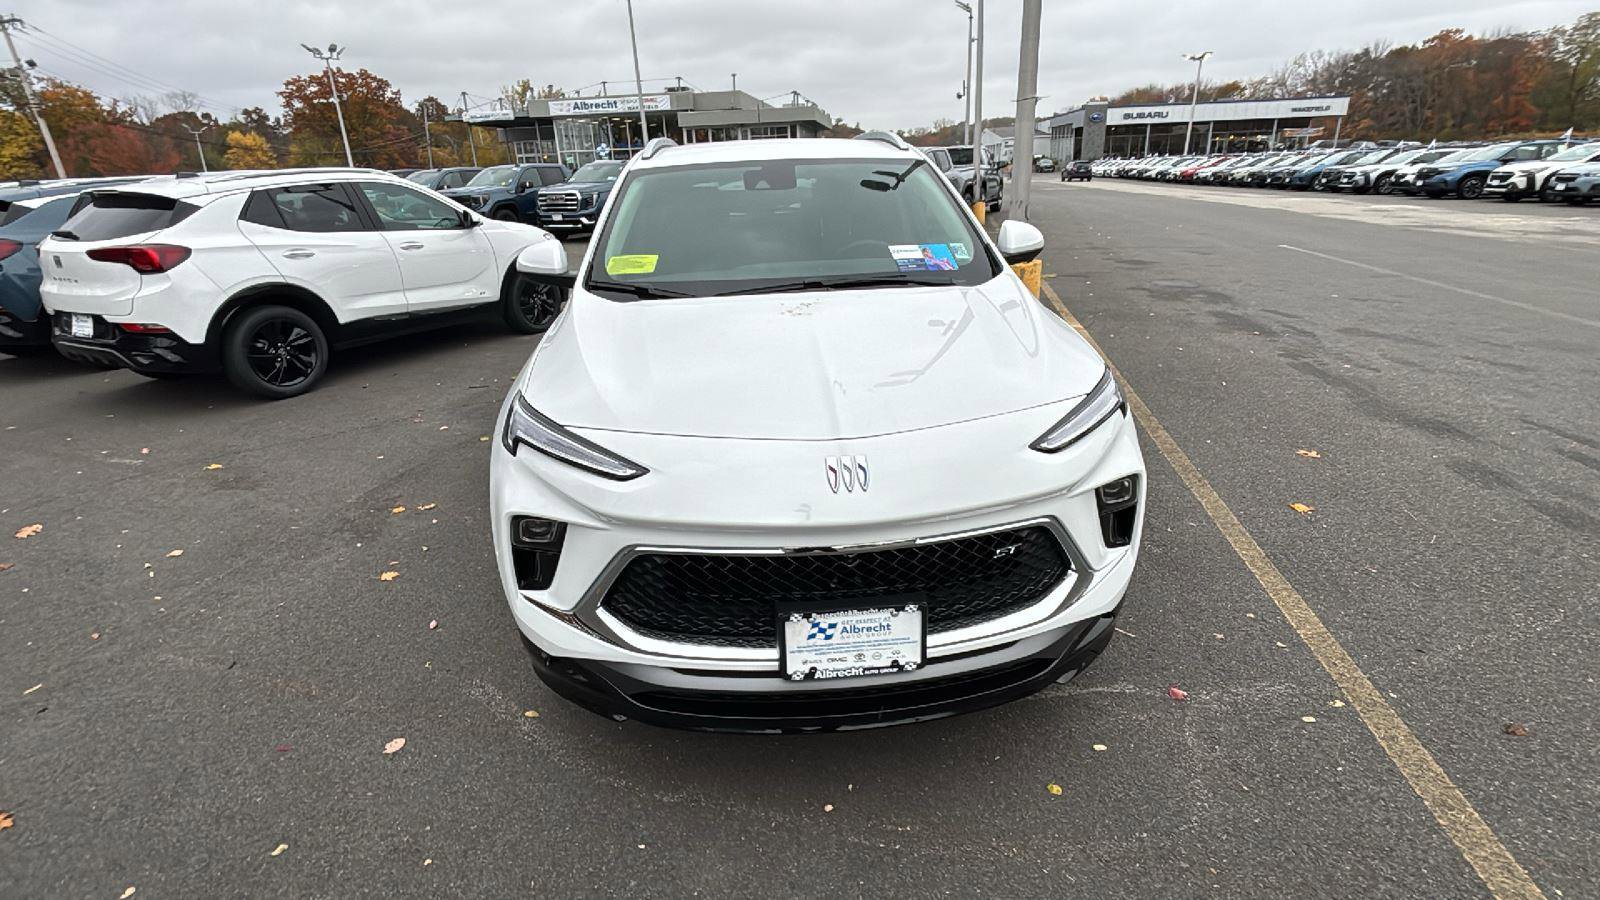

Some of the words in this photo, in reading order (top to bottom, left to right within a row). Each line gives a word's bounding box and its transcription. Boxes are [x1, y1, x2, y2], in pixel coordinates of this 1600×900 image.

[573, 100, 618, 111] Albrecht
[1122, 111, 1169, 120] SUBARU
[840, 622, 892, 635] Albrecht
[814, 667, 864, 678] Albrecht
